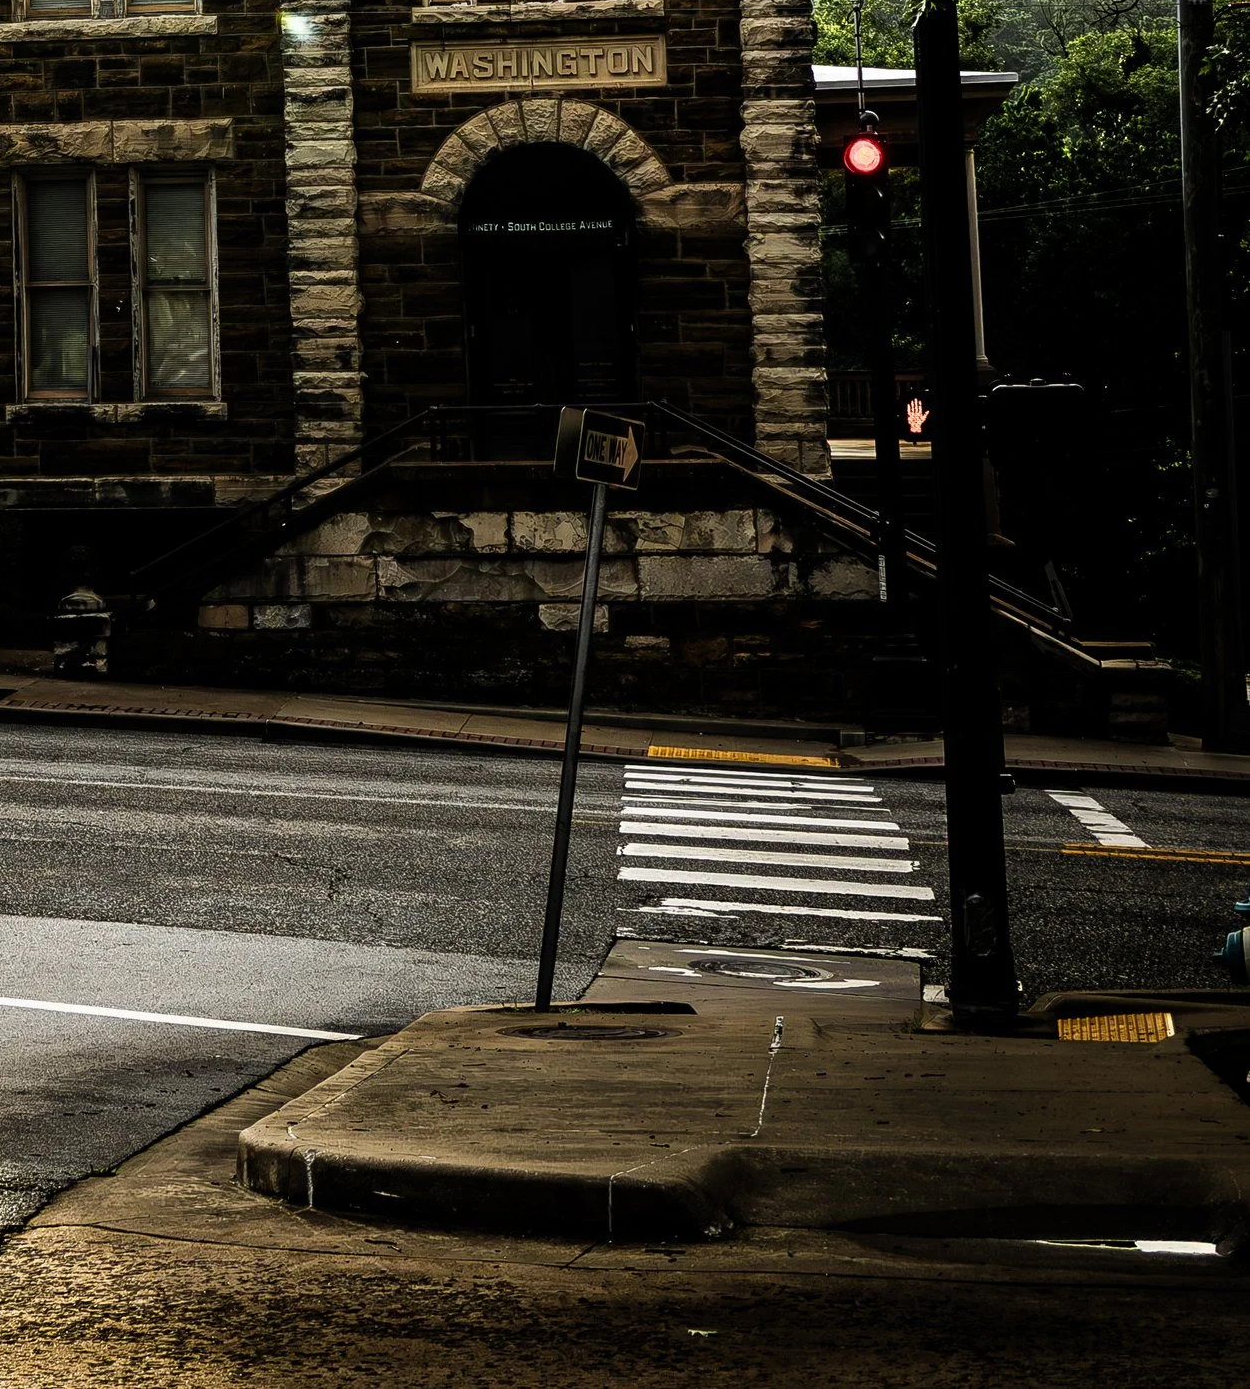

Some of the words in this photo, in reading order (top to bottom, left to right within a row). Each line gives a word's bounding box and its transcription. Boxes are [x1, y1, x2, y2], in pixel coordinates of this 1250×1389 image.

[424, 46, 653, 80] WASHINGTON
[586, 433, 605, 463] ONE
[608, 435, 628, 467] WAY
